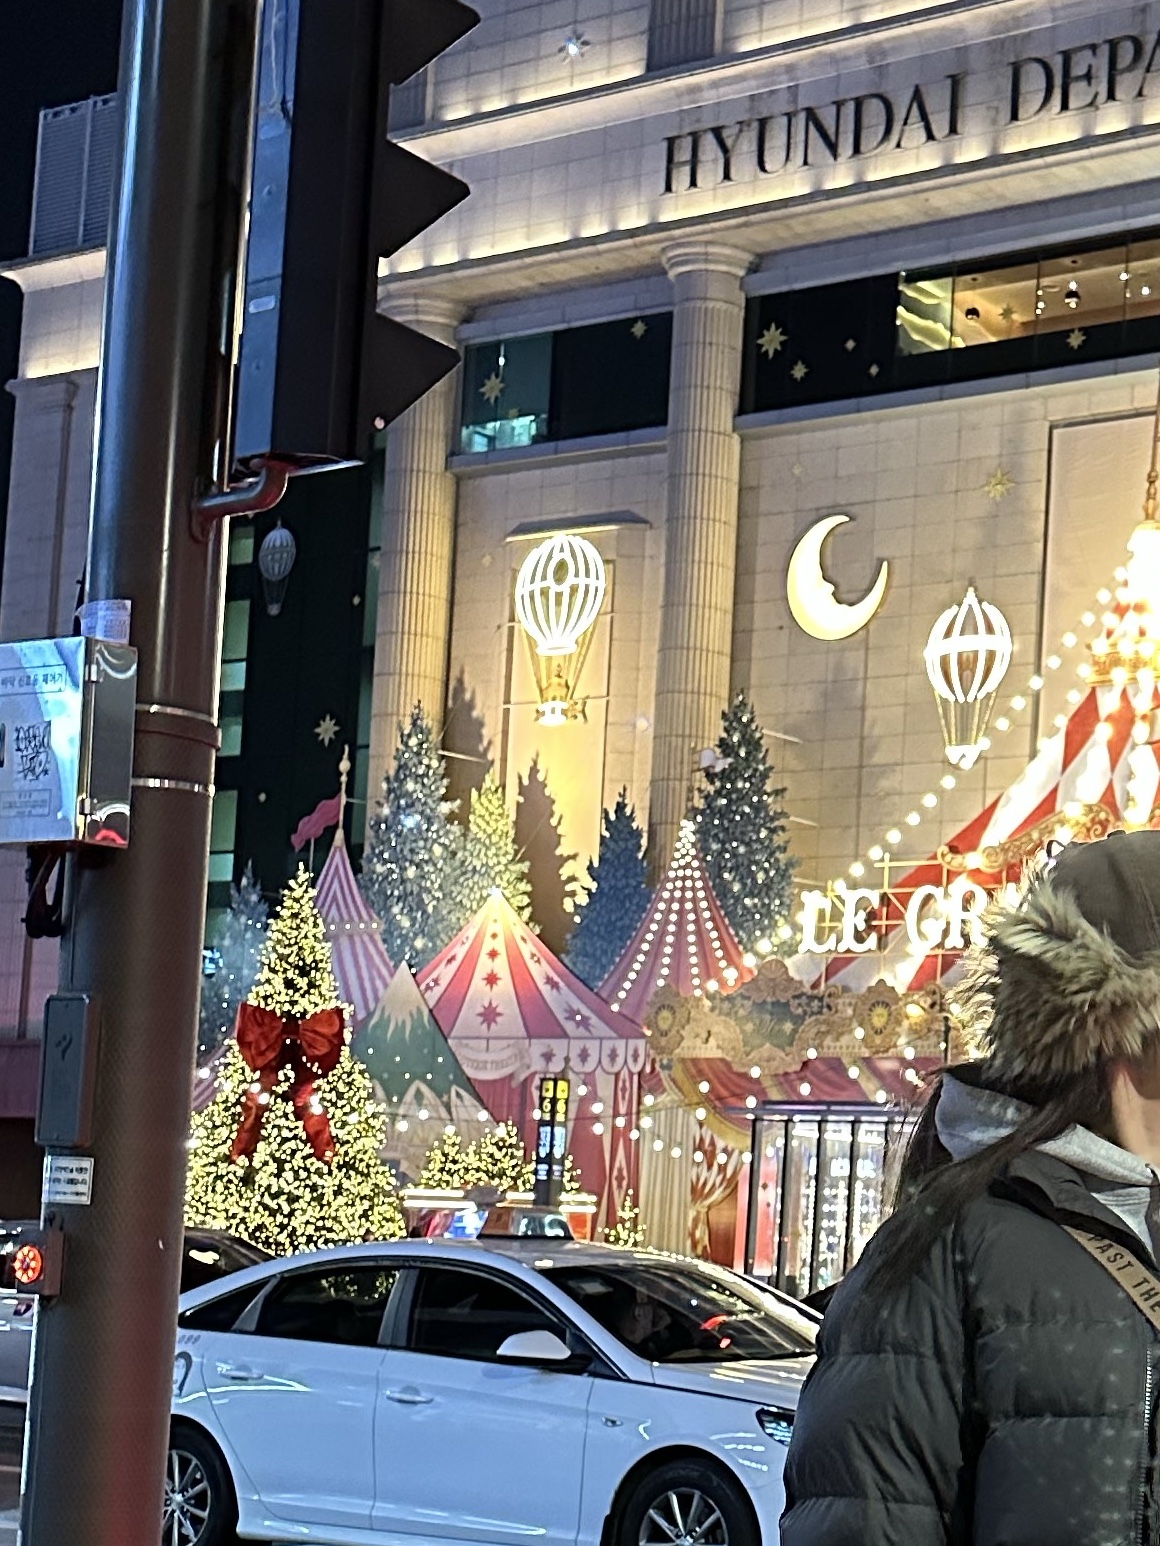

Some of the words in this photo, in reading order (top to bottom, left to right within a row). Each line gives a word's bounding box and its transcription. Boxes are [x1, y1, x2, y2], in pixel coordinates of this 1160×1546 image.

[661, 72, 969, 196] HYUNDAI
[798, 888, 880, 954] LE
[1087, 1235, 1134, 1272] PAST
